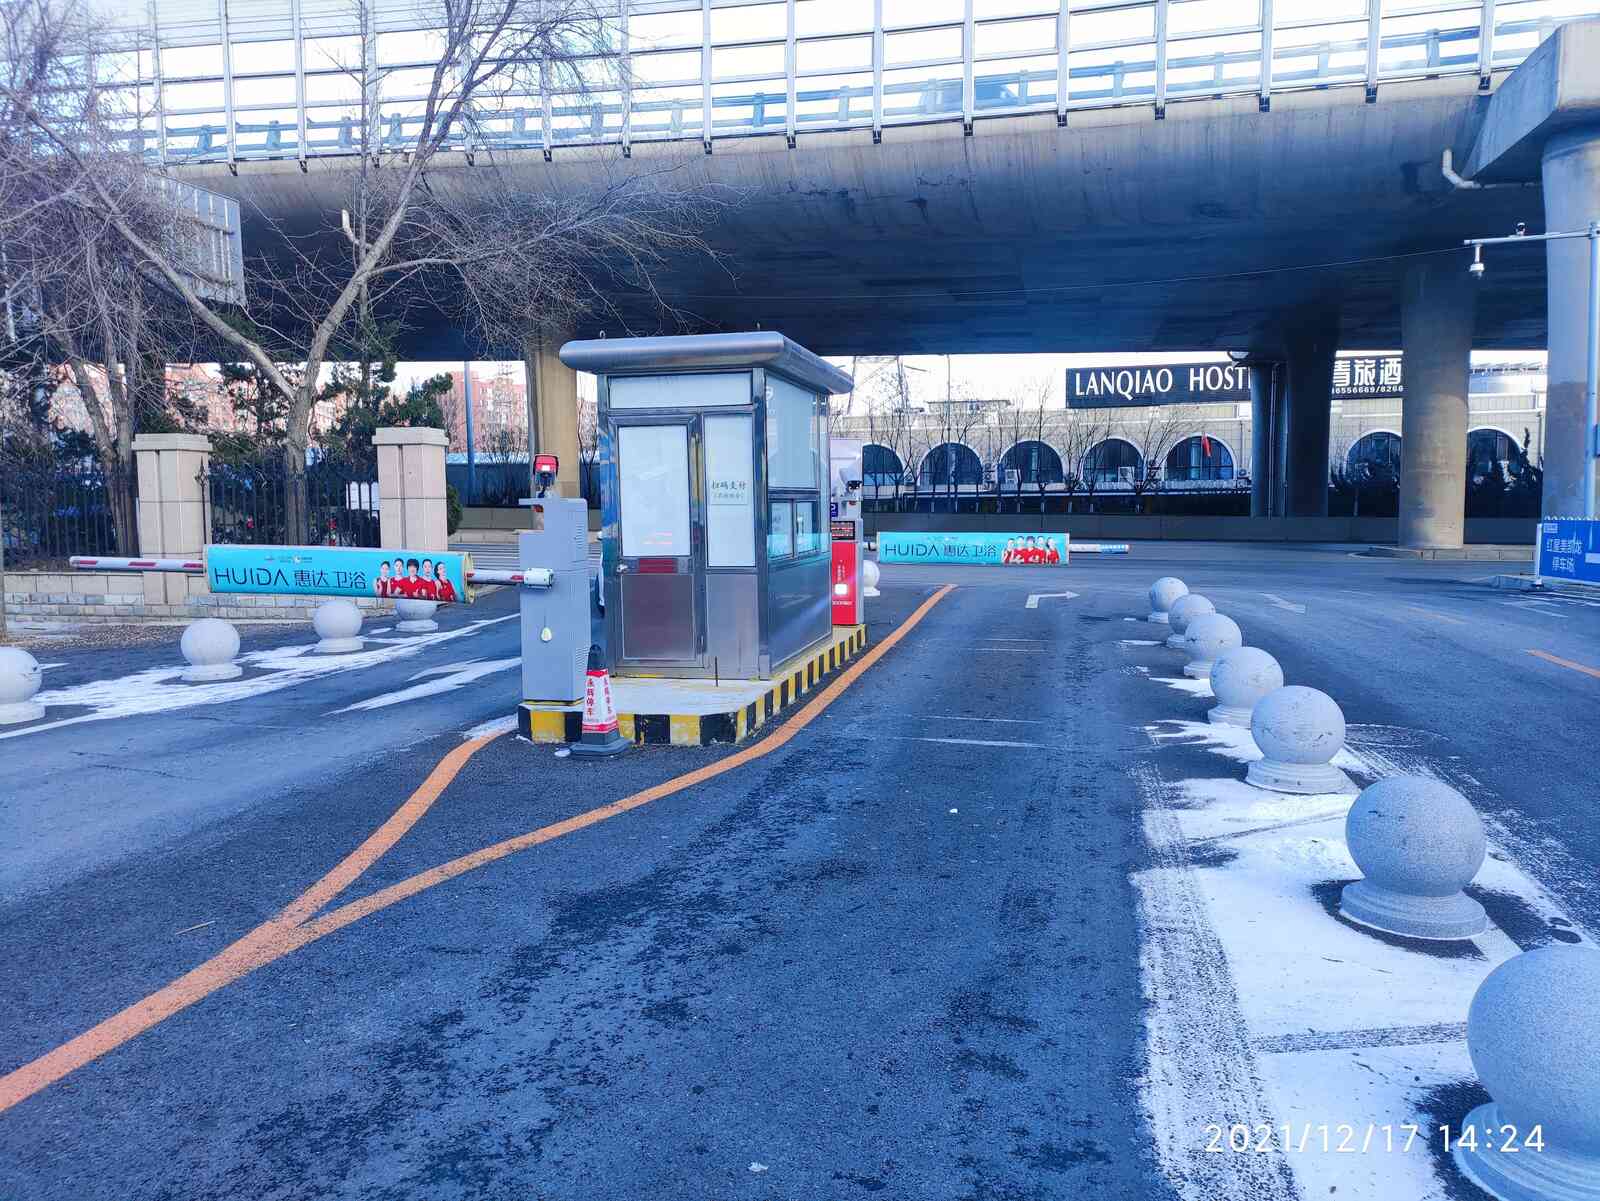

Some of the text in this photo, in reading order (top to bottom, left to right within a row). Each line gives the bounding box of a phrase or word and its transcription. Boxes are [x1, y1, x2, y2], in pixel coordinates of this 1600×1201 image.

[1075, 366, 1251, 400] LANQIAO HOST
[885, 544, 940, 557] HUIDA
[214, 568, 367, 589] HUIDA 惠达卫浴
